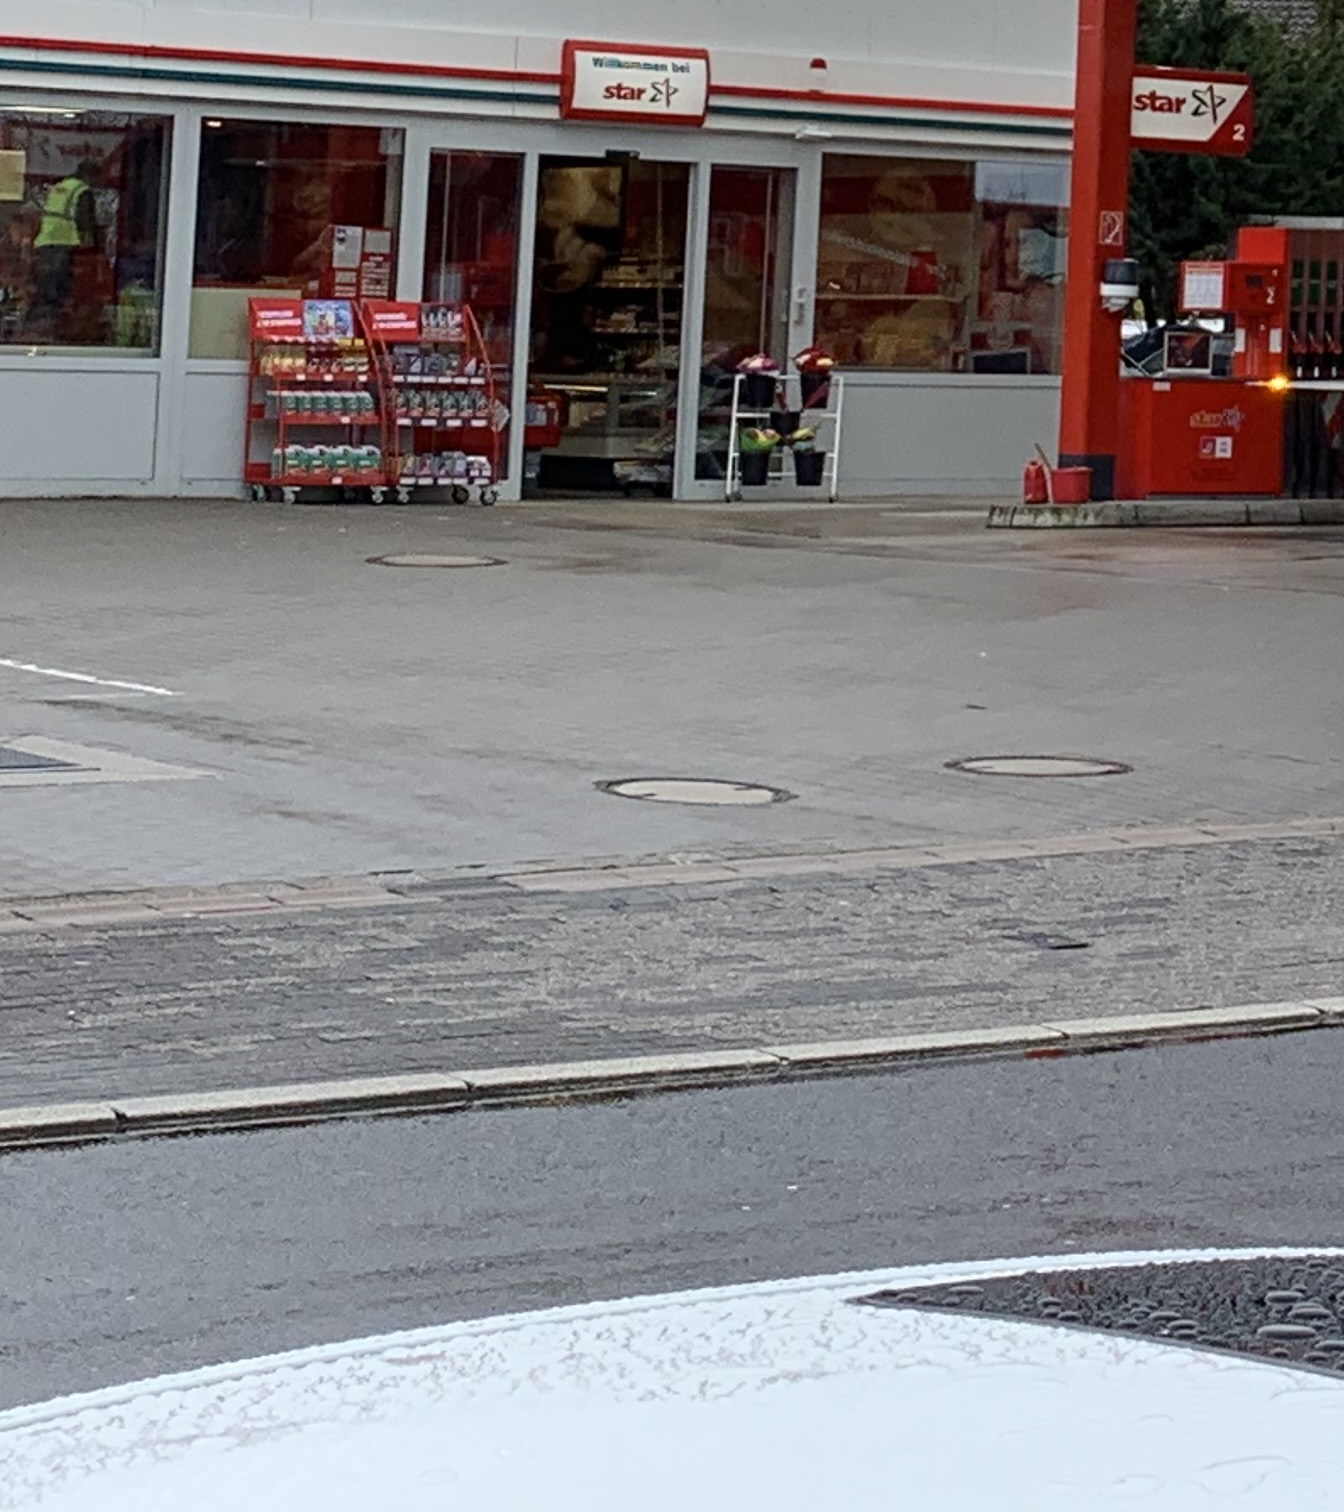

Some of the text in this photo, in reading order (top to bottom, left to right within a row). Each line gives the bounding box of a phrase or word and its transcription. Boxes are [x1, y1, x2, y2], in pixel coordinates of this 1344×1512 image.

[671, 62, 691, 74] bei
[602, 81, 648, 102] star
[1133, 89, 1187, 115] star
[1232, 123, 1247, 142] 2
